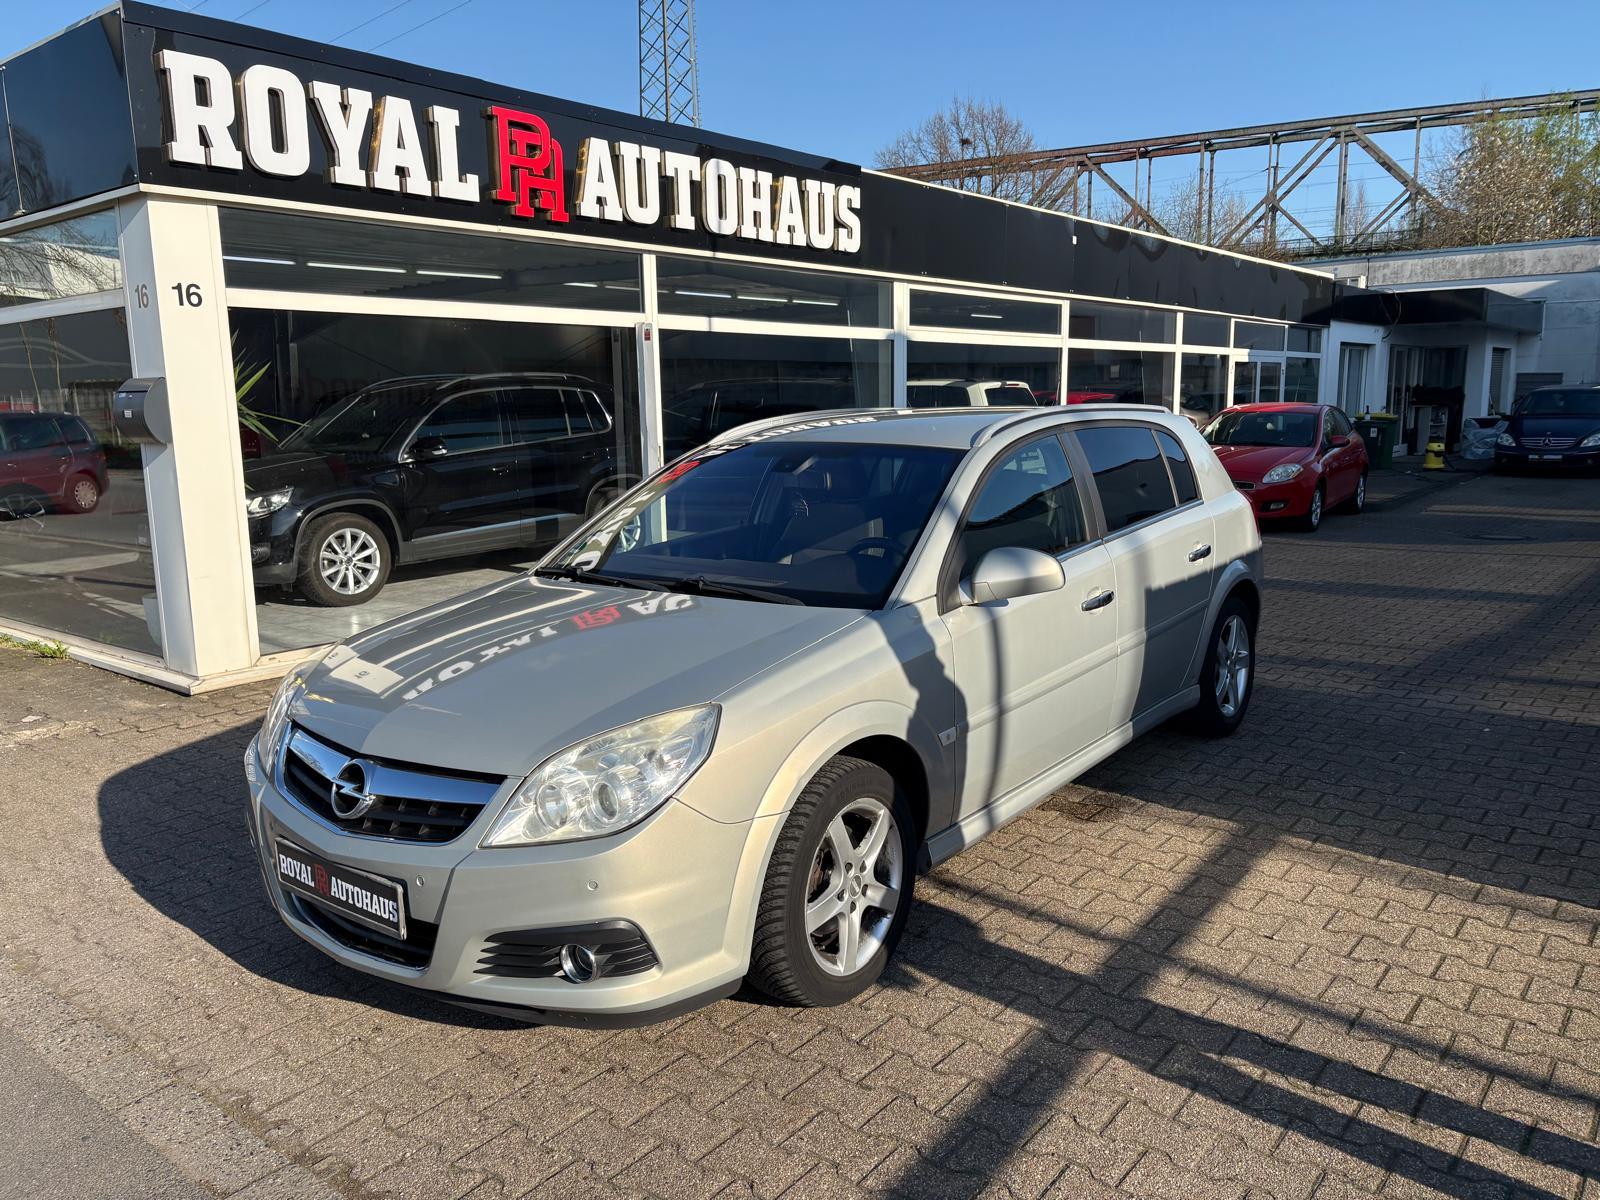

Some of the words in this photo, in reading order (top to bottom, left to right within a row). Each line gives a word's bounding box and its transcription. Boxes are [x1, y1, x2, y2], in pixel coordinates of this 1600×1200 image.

[157, 49, 480, 202] ROYAL
[578, 137, 861, 253] AUTOHAUS
[134, 283, 149, 309] 16
[171, 282, 203, 308] 16
[279, 853, 315, 888] ROYAL
[331, 876, 398, 923] AUTOHAUS
